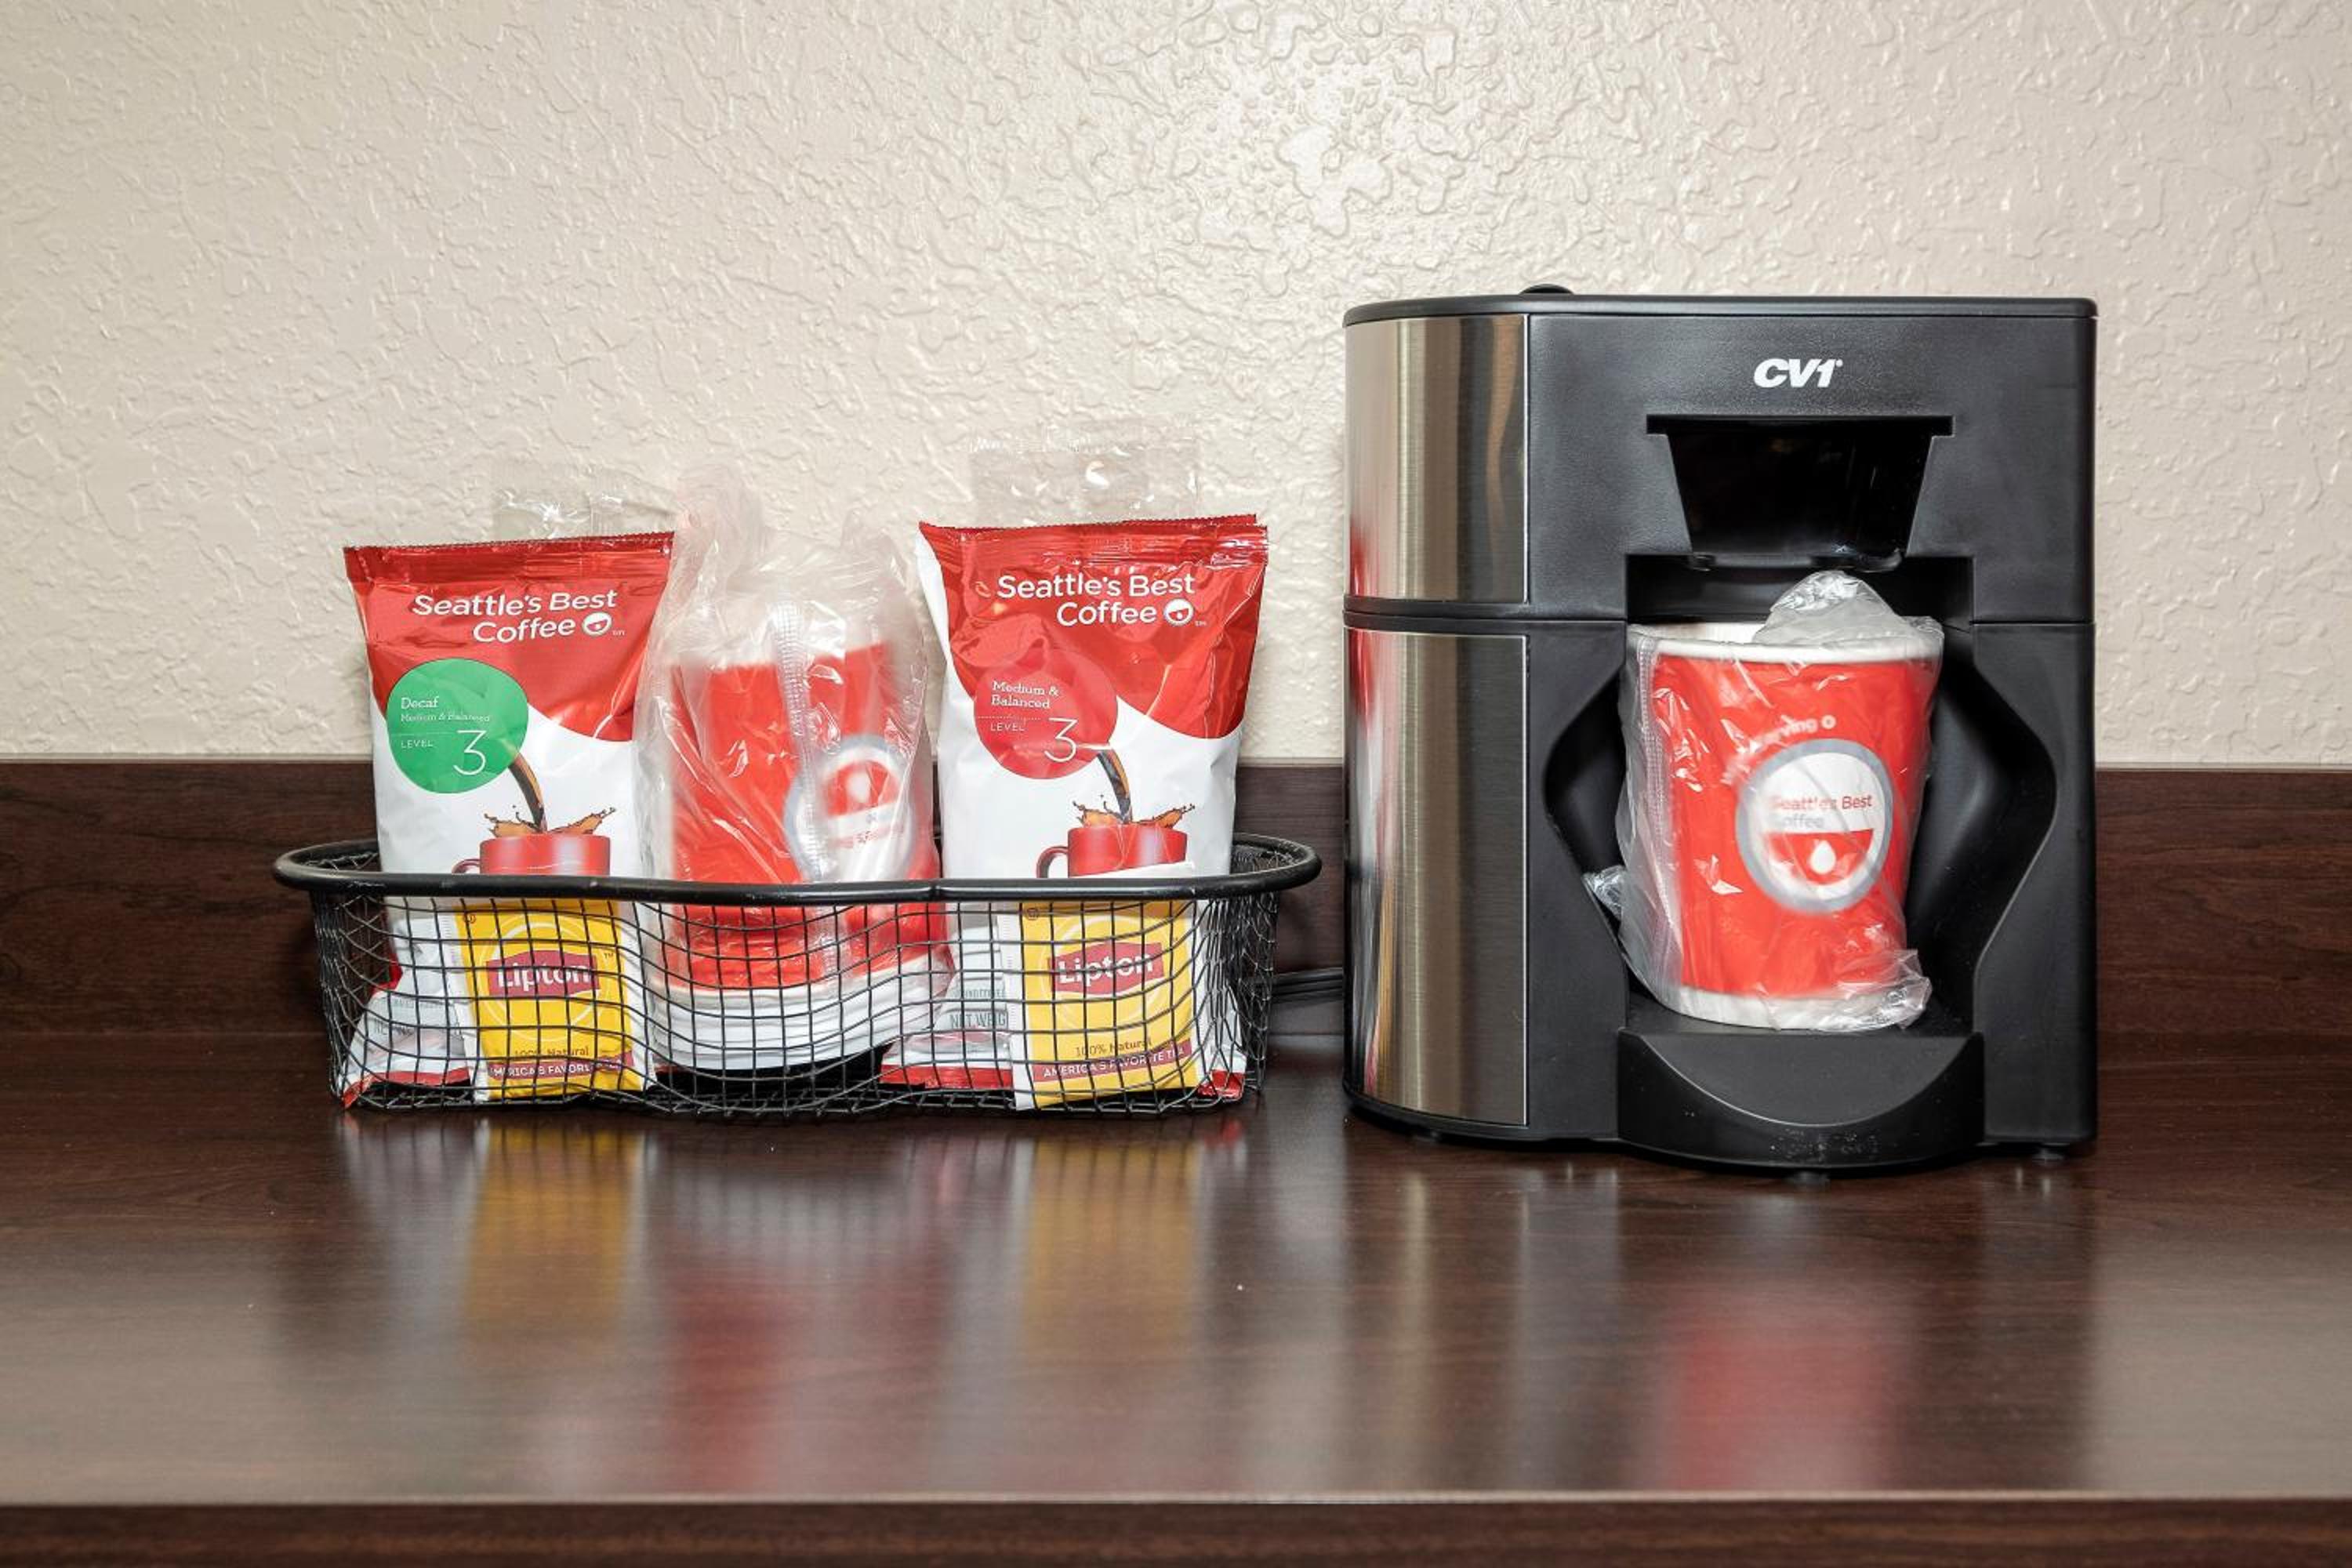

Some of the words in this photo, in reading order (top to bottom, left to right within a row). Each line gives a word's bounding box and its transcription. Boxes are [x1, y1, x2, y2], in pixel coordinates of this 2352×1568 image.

[1754, 358, 1836, 388] CV1
[997, 572, 1121, 599] Seattle's
[1129, 573, 1196, 597] Best
[412, 593, 543, 616] Seattle's
[549, 589, 618, 612] Best
[1057, 601, 1157, 627] Coffee
[473, 617, 576, 644] Coffee
[991, 694, 1051, 709] Balanced
[993, 680, 1045, 695] Medium
[1048, 685, 1059, 697] &
[401, 695, 440, 710] Decaf
[990, 722, 1025, 731] LEVEL
[1044, 717, 1079, 763] 3
[401, 739, 434, 749] LEVEL
[453, 729, 487, 775] 3
[1842, 794, 1873, 810] Best
[497, 962, 593, 992] Lipton
[1058, 954, 1153, 988] Lipton
